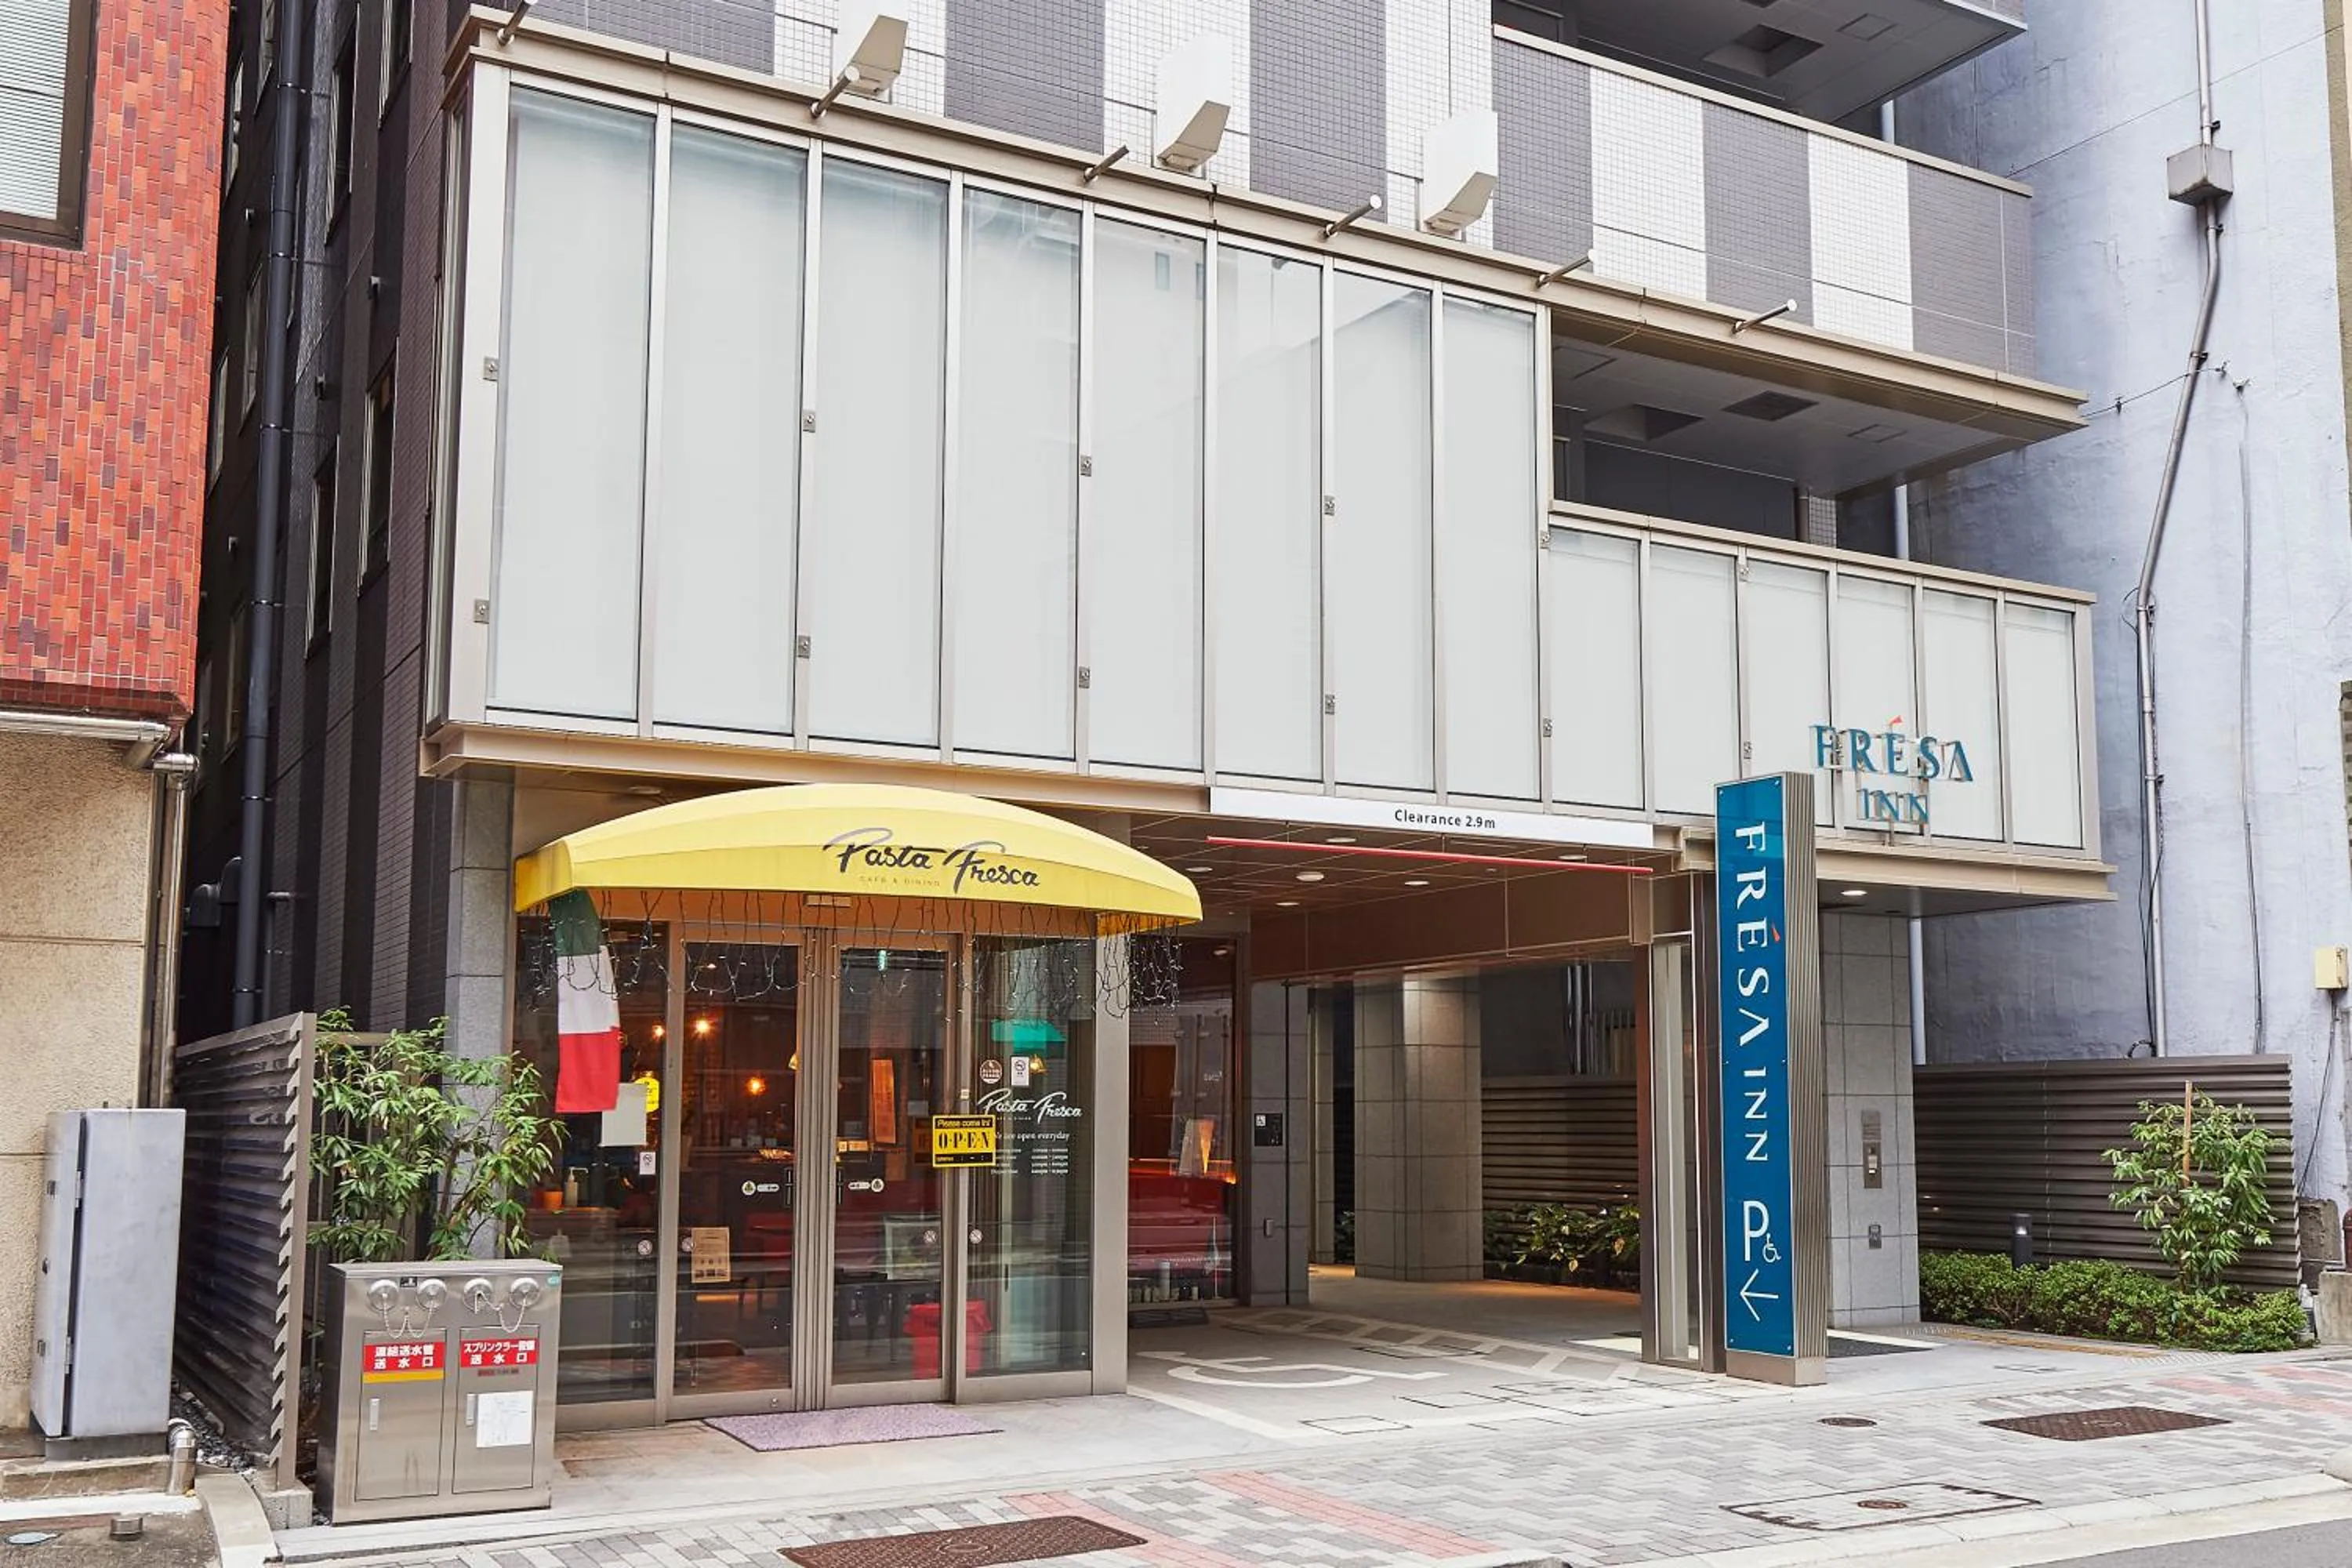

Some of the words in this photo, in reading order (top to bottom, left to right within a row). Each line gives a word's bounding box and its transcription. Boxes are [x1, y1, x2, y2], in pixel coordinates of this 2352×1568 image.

[1395, 808, 1461, 826] Clearance
[1465, 815, 1496, 829] 2.9m
[1856, 788, 1930, 824] INN
[822, 827, 947, 873] Pasta
[942, 840, 1040, 894] Fresca
[977, 1087, 1036, 1116] Pasta
[1033, 1091, 1082, 1124] Fresca
[1743, 1065, 1769, 1162] INN
[1037, 1131, 1070, 1142] everyday
[1743, 1200, 1769, 1261] P
